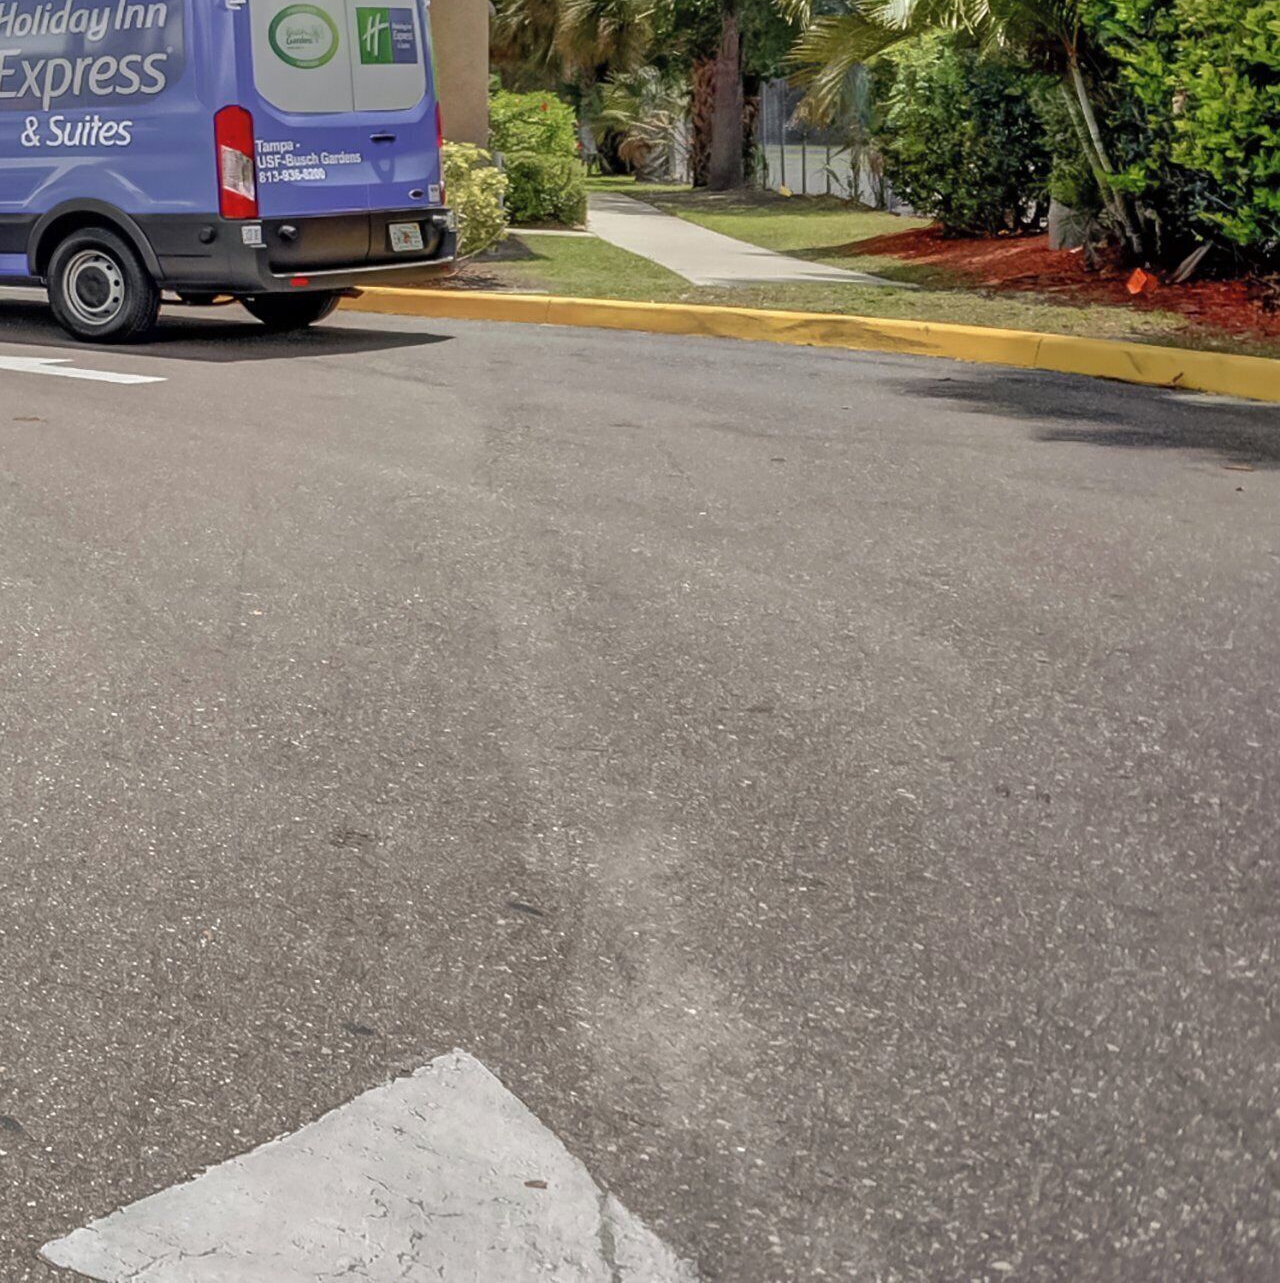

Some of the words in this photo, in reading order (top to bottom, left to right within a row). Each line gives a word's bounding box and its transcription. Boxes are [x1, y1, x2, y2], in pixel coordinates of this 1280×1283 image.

[21, 116, 40, 146] &
[46, 115, 133, 146] Suites
[256, 140, 293, 153] Tampa
[257, 153, 319, 169] USF-Busch
[320, 151, 361, 164] Gardens
